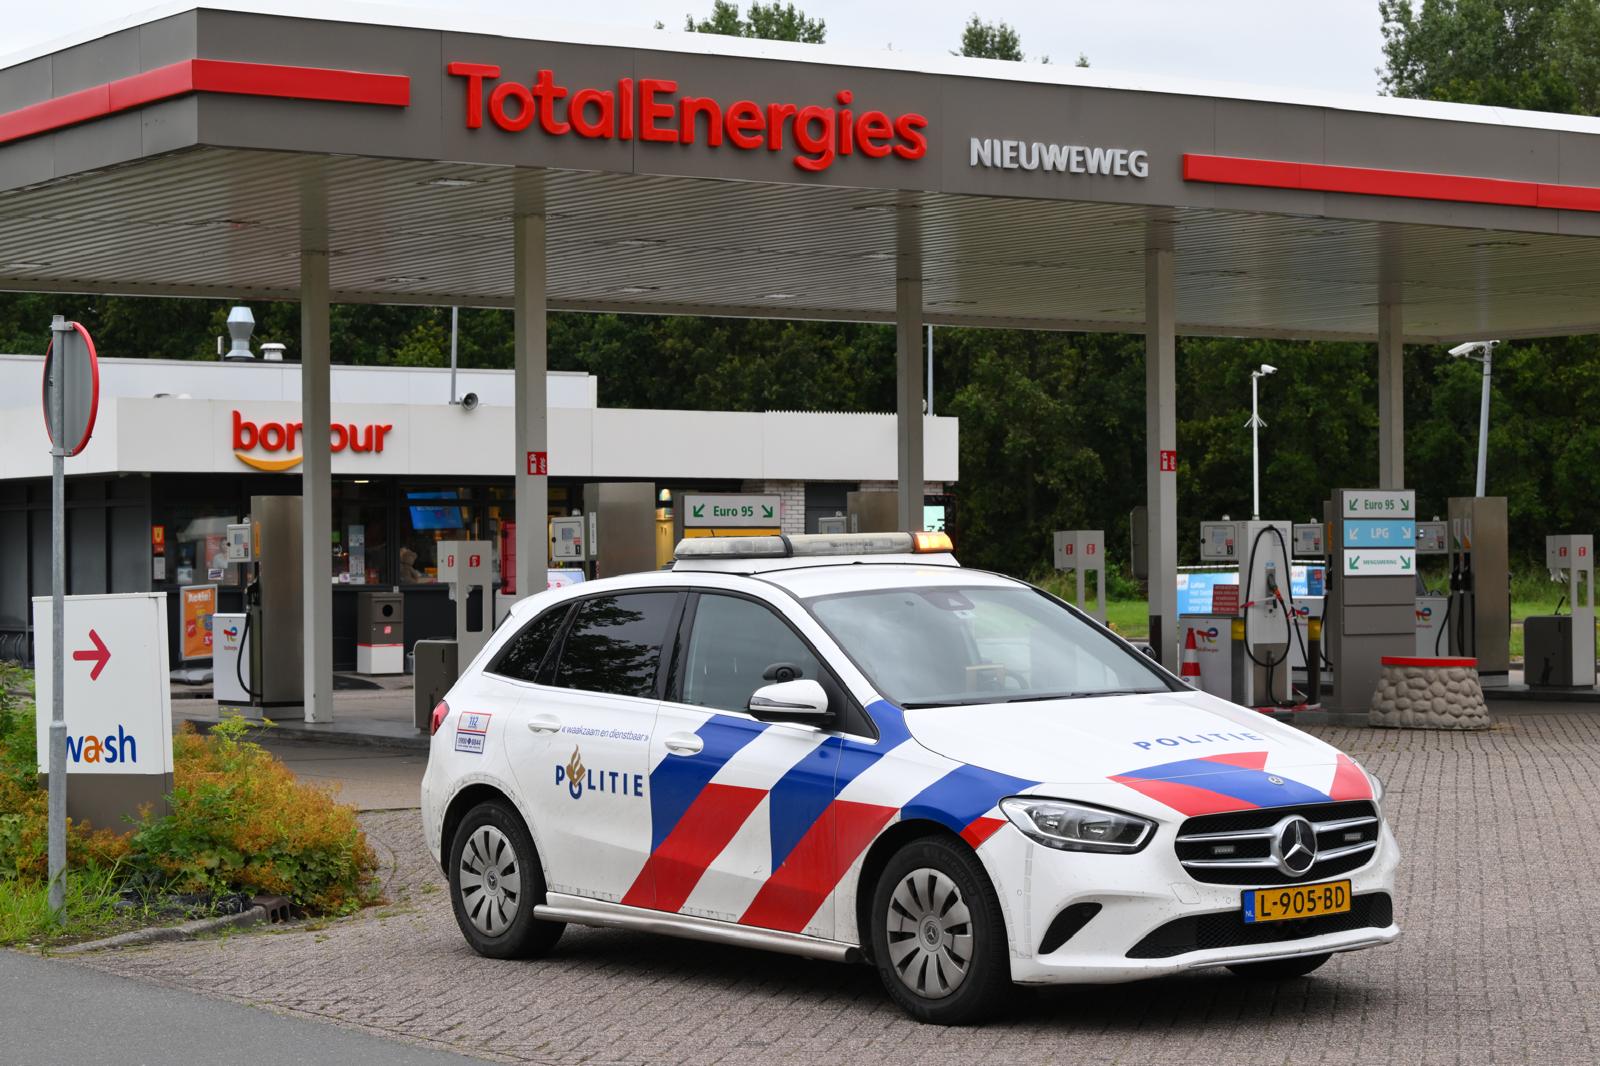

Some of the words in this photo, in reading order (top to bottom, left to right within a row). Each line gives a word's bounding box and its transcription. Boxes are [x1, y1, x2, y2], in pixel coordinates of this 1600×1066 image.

[448, 61, 929, 173] TotalEnergies
[970, 137, 1149, 179] NIEUWEWEG
[232, 410, 393, 453] bonour
[713, 505, 738, 517] Euro
[741, 506, 753, 517] 95
[1364, 499, 1383, 510] Euro
[1385, 499, 1394, 510] 95
[1370, 527, 1389, 539] LPG
[566, 725, 600, 736] waakzaam
[600, 729, 609, 737] en
[609, 729, 644, 741] dienstbaar
[1133, 732, 1265, 750] POLITIE
[556, 764, 643, 799] POLITIE
[1261, 887, 1345, 917] L-905-BD
